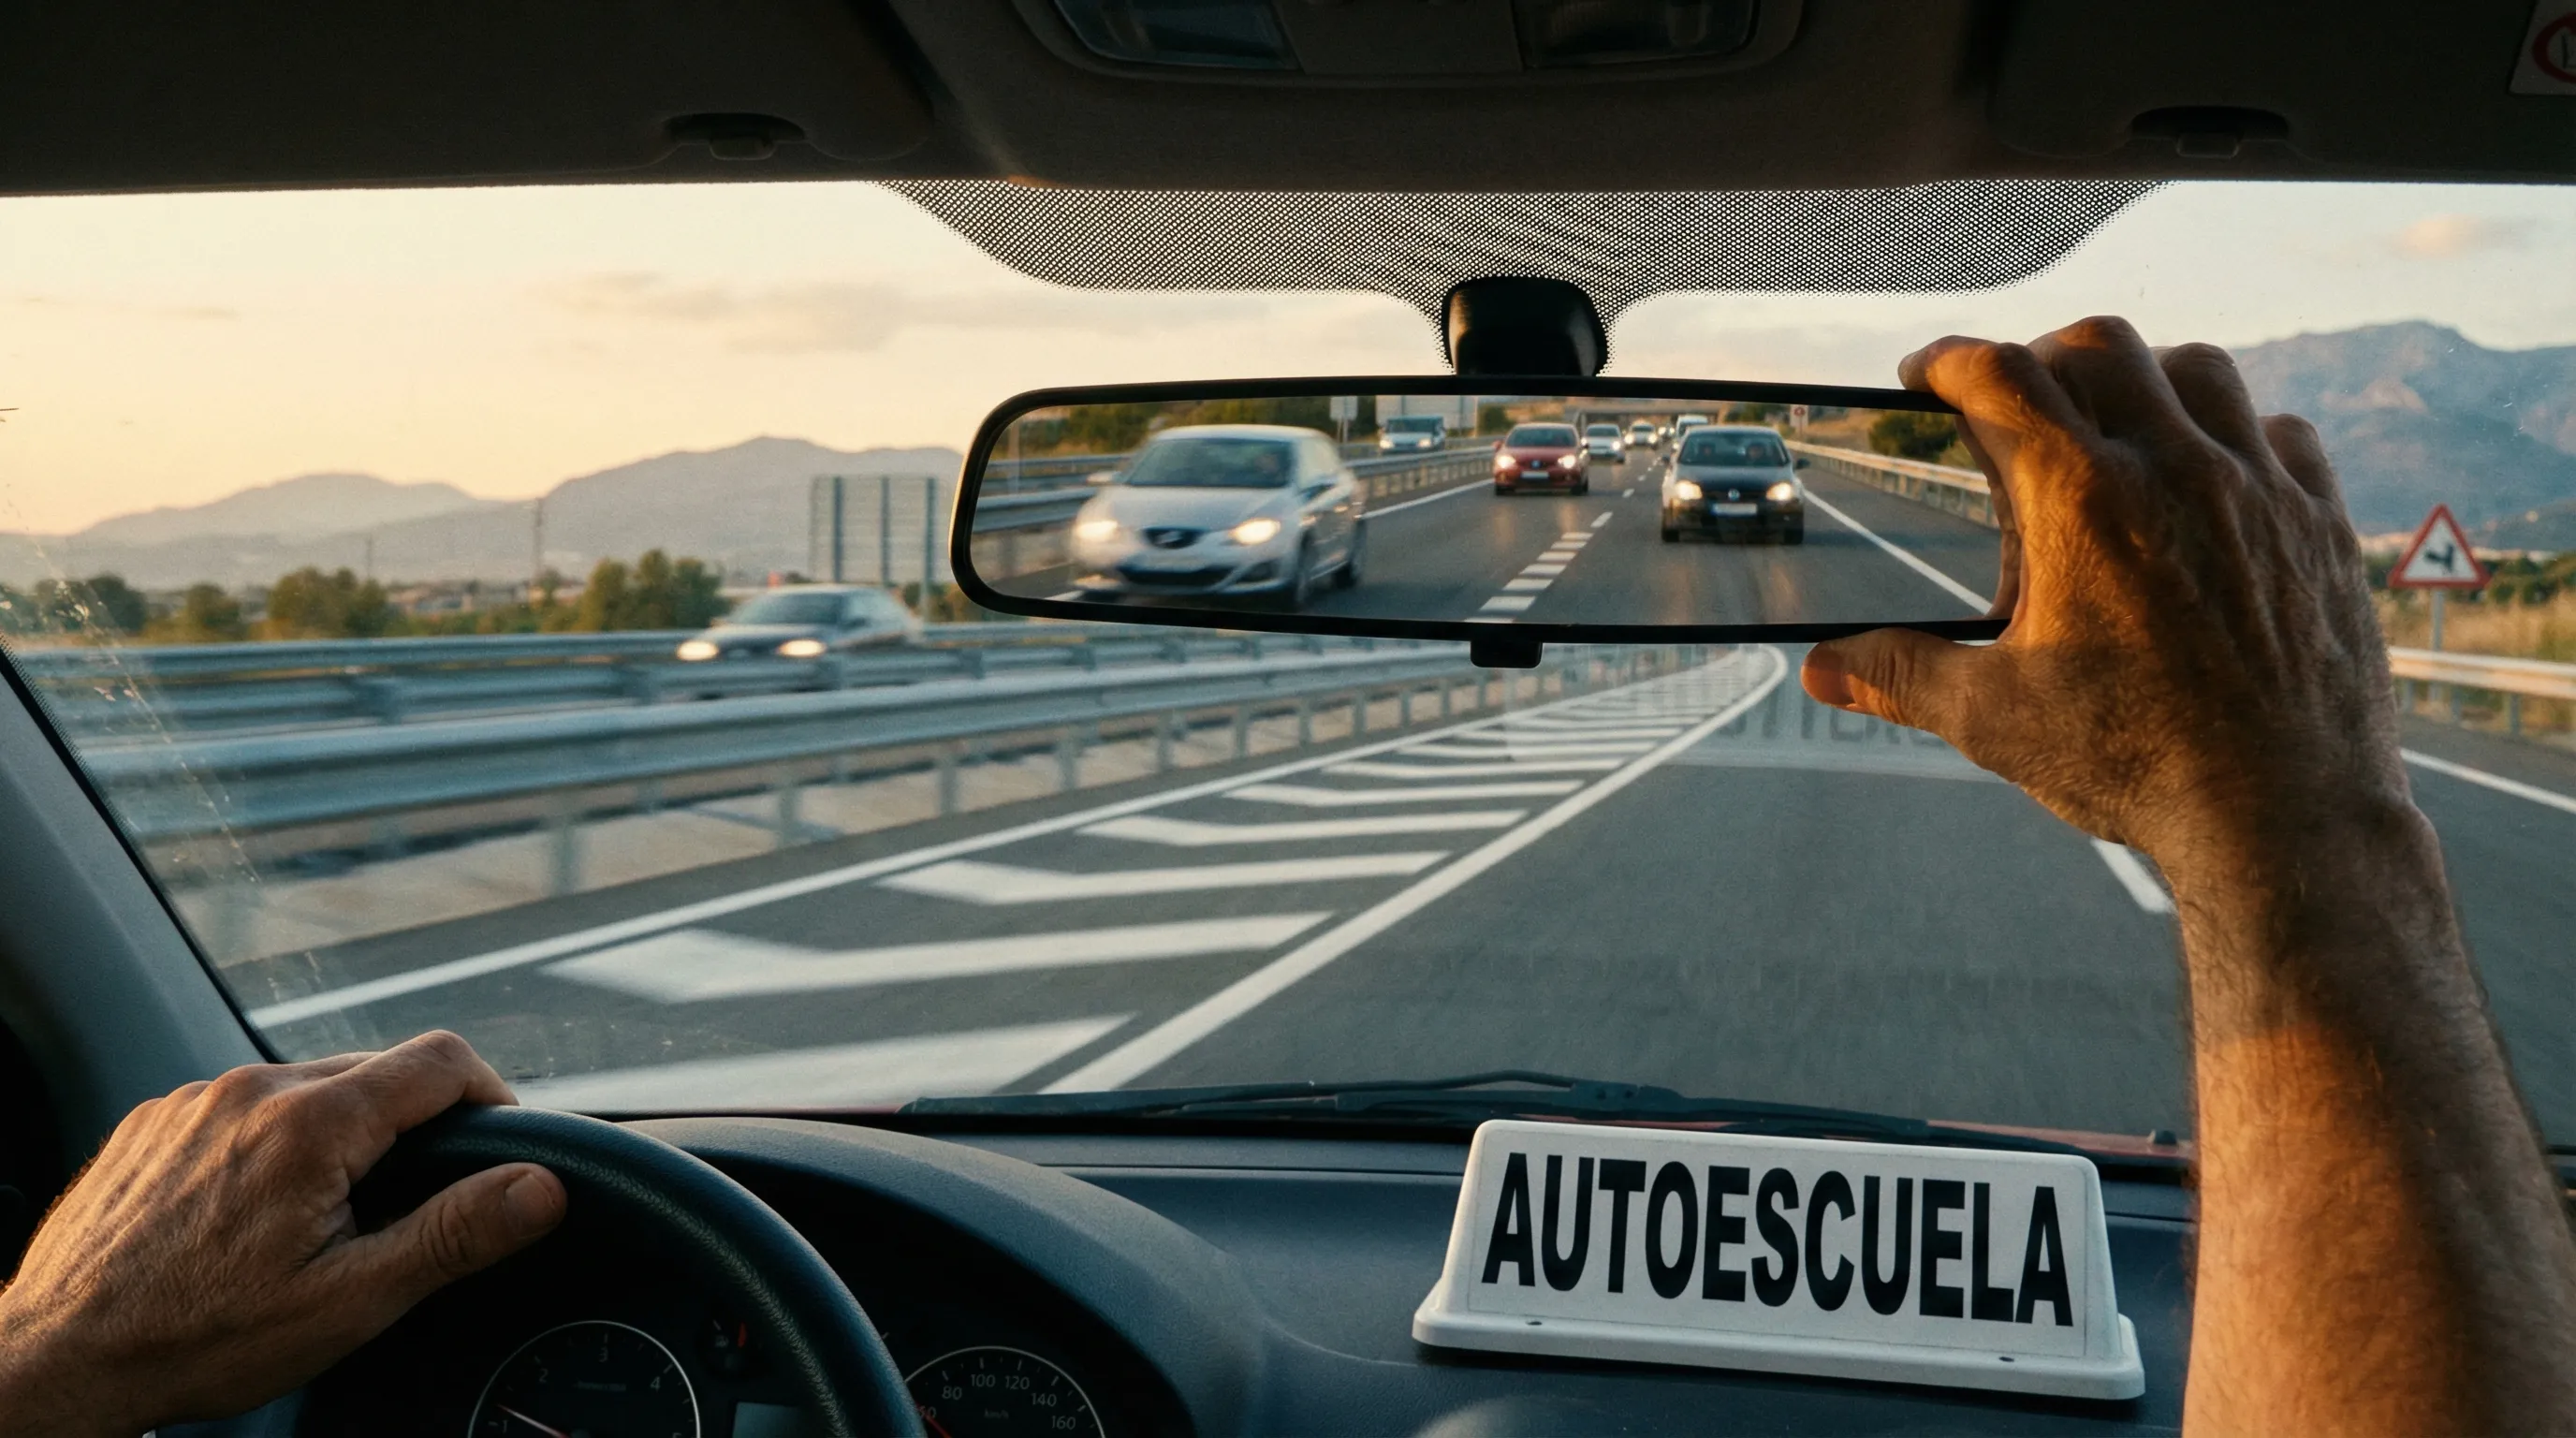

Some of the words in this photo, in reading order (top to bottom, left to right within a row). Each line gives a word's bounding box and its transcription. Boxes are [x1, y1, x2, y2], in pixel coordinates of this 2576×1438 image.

[1482, 1152, 2072, 1326] AUTOESCUELA
[599, 1348, 609, 1363] 3
[539, 1368, 549, 1384] 2
[971, 1373, 996, 1387] 100
[1005, 1375, 1030, 1390] 120
[650, 1376, 661, 1392] 4
[942, 1385, 962, 1400] 80
[1032, 1392, 1057, 1407] 140
[1052, 1415, 1076, 1430] 160
